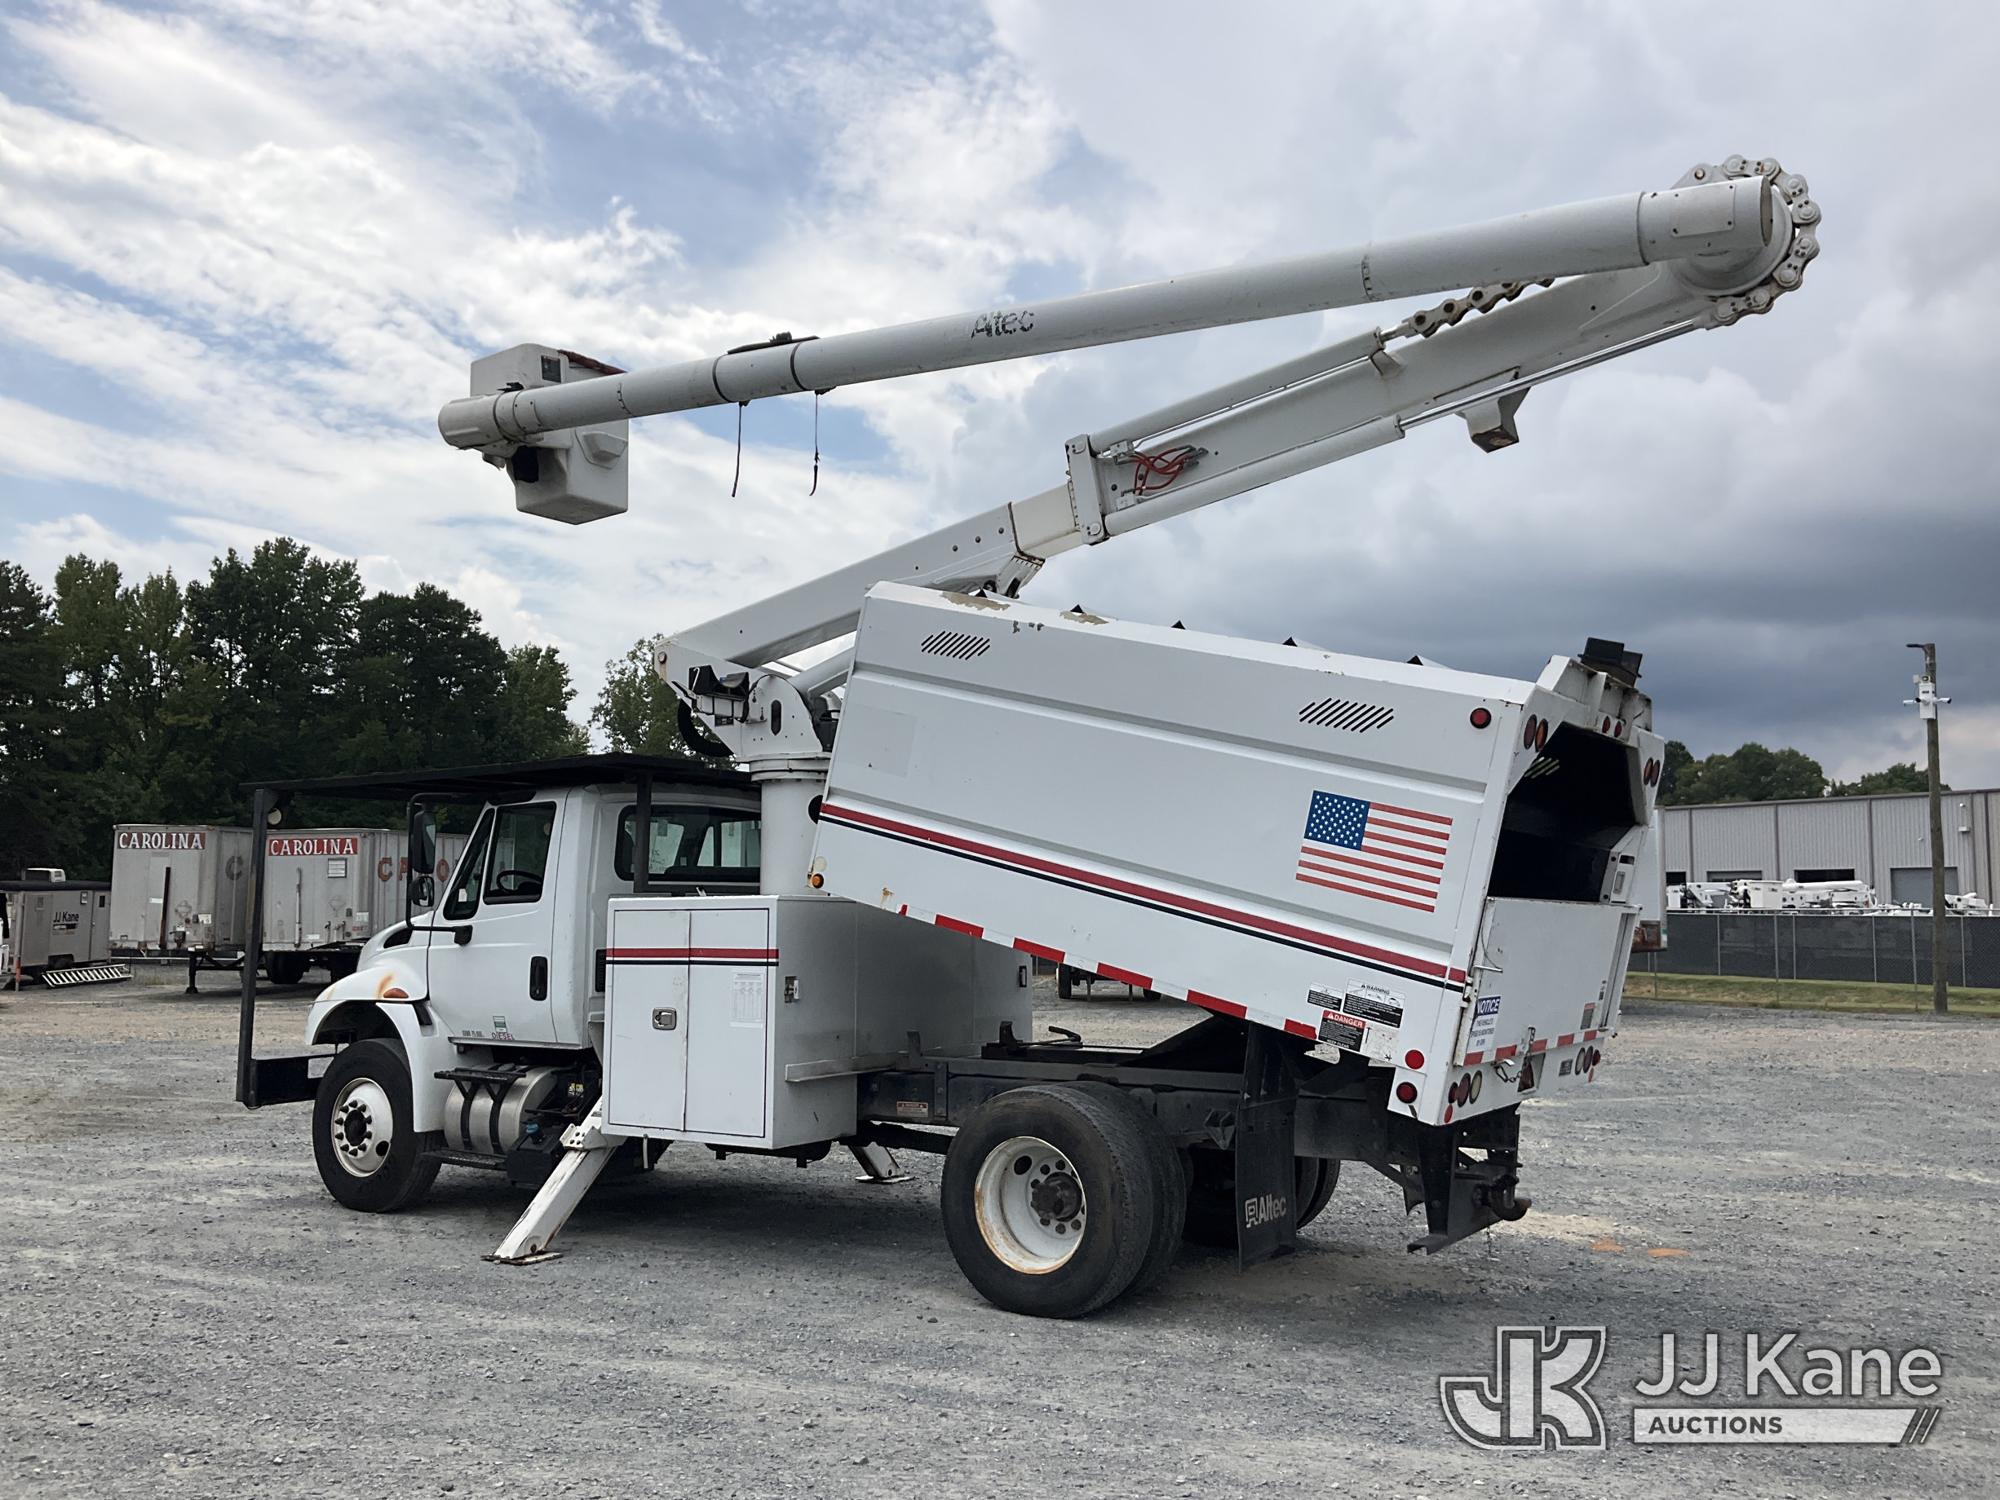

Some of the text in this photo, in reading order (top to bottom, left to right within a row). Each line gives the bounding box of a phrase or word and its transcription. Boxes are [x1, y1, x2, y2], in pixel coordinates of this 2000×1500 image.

[119, 832, 203, 849] CAROLINA
[270, 838, 354, 855] CAROLINA
[62, 911, 80, 922] Kane
[1477, 999, 1500, 1014] NOTICE
[1333, 1013, 1363, 1028] DANGER
[1259, 1193, 1287, 1224] Altec
